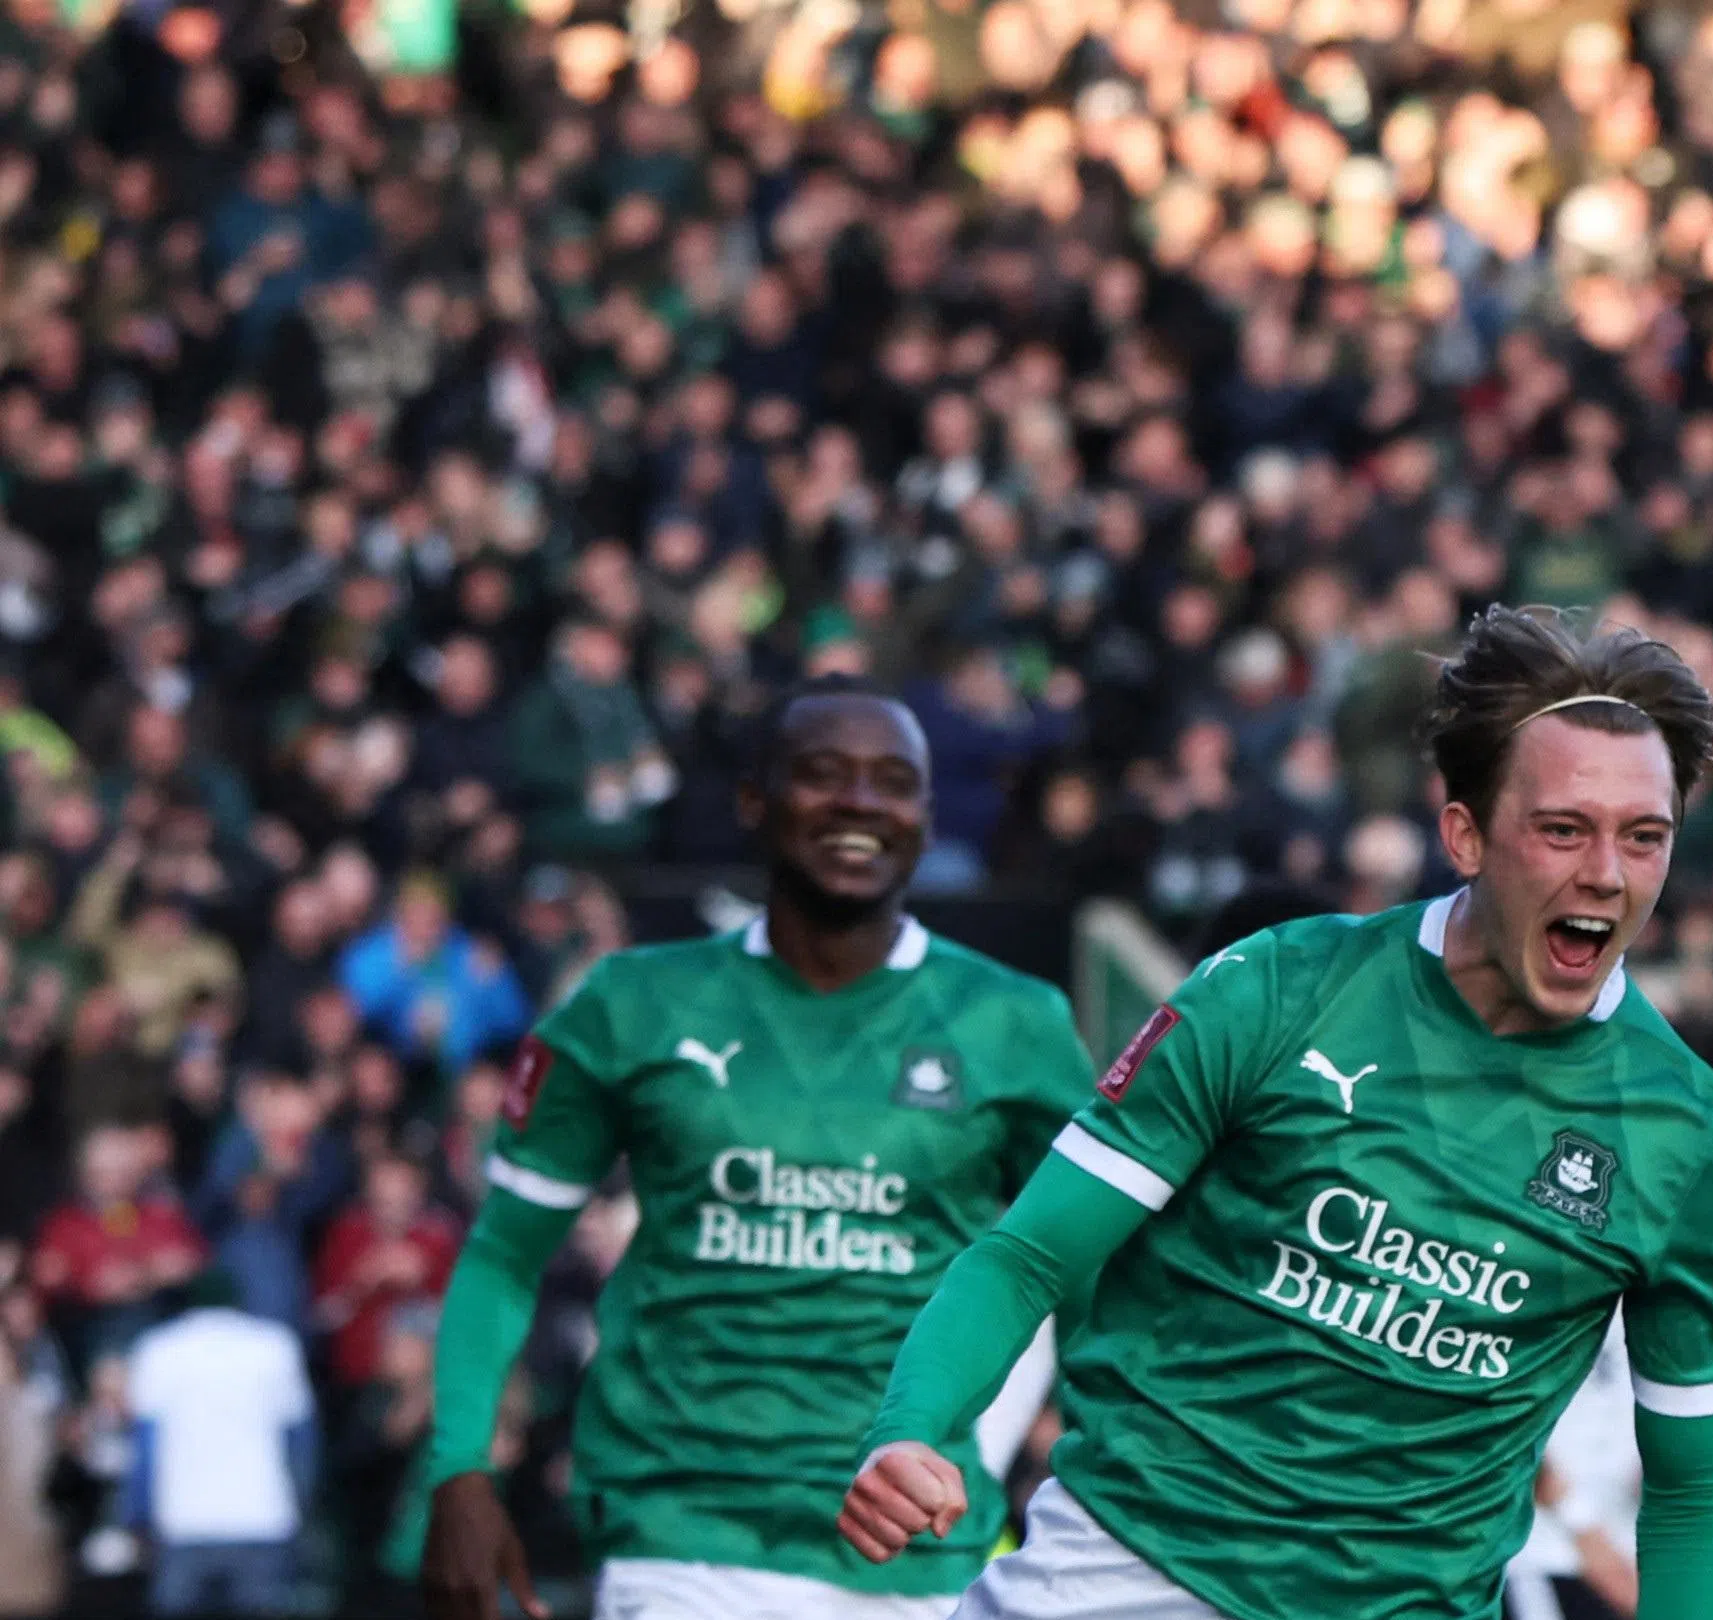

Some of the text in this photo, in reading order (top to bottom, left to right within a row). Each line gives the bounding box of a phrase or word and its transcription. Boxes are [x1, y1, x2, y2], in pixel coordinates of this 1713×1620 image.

[709, 1147, 907, 1216] Classic
[694, 1202, 916, 1275] Builders
[1306, 1187, 1531, 1314] Classic
[1257, 1240, 1513, 1378] Builders
